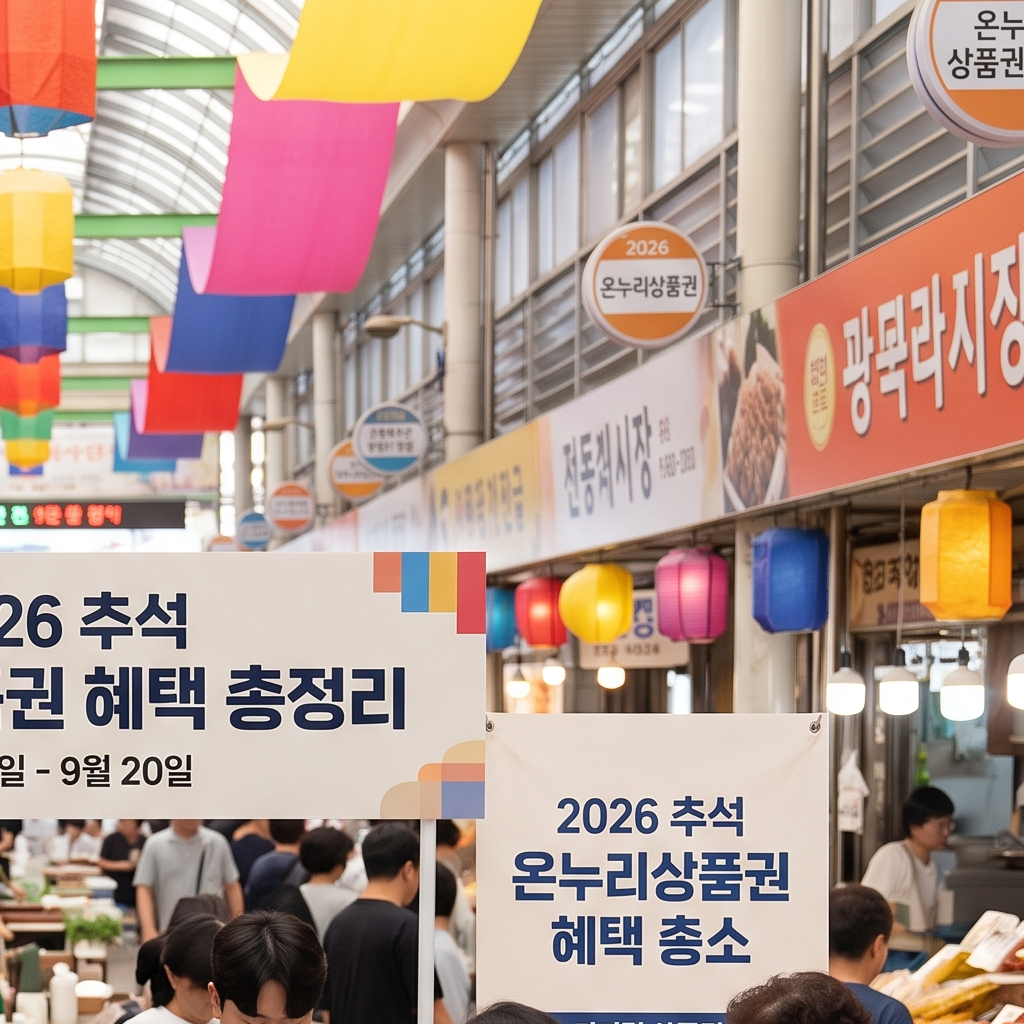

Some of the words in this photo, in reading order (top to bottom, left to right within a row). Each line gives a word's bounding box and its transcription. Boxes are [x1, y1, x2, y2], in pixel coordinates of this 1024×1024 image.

[947, 46, 1024, 80] 상품권
[625, 239, 670, 256] 2026
[600, 274, 697, 299] 온누리상품권
[79, 591, 188, 650] 추석
[84, 664, 206, 731] 혜택
[225, 663, 407, 731] 총정리
[59, 754, 111, 788] 9월
[120, 754, 193, 788] 20일
[556, 797, 660, 835] 2026
[670, 795, 744, 837] 추석
[512, 851, 790, 903] 온누리상품권
[551, 915, 643, 966] 혜택
[658, 914, 752, 967] 총소
